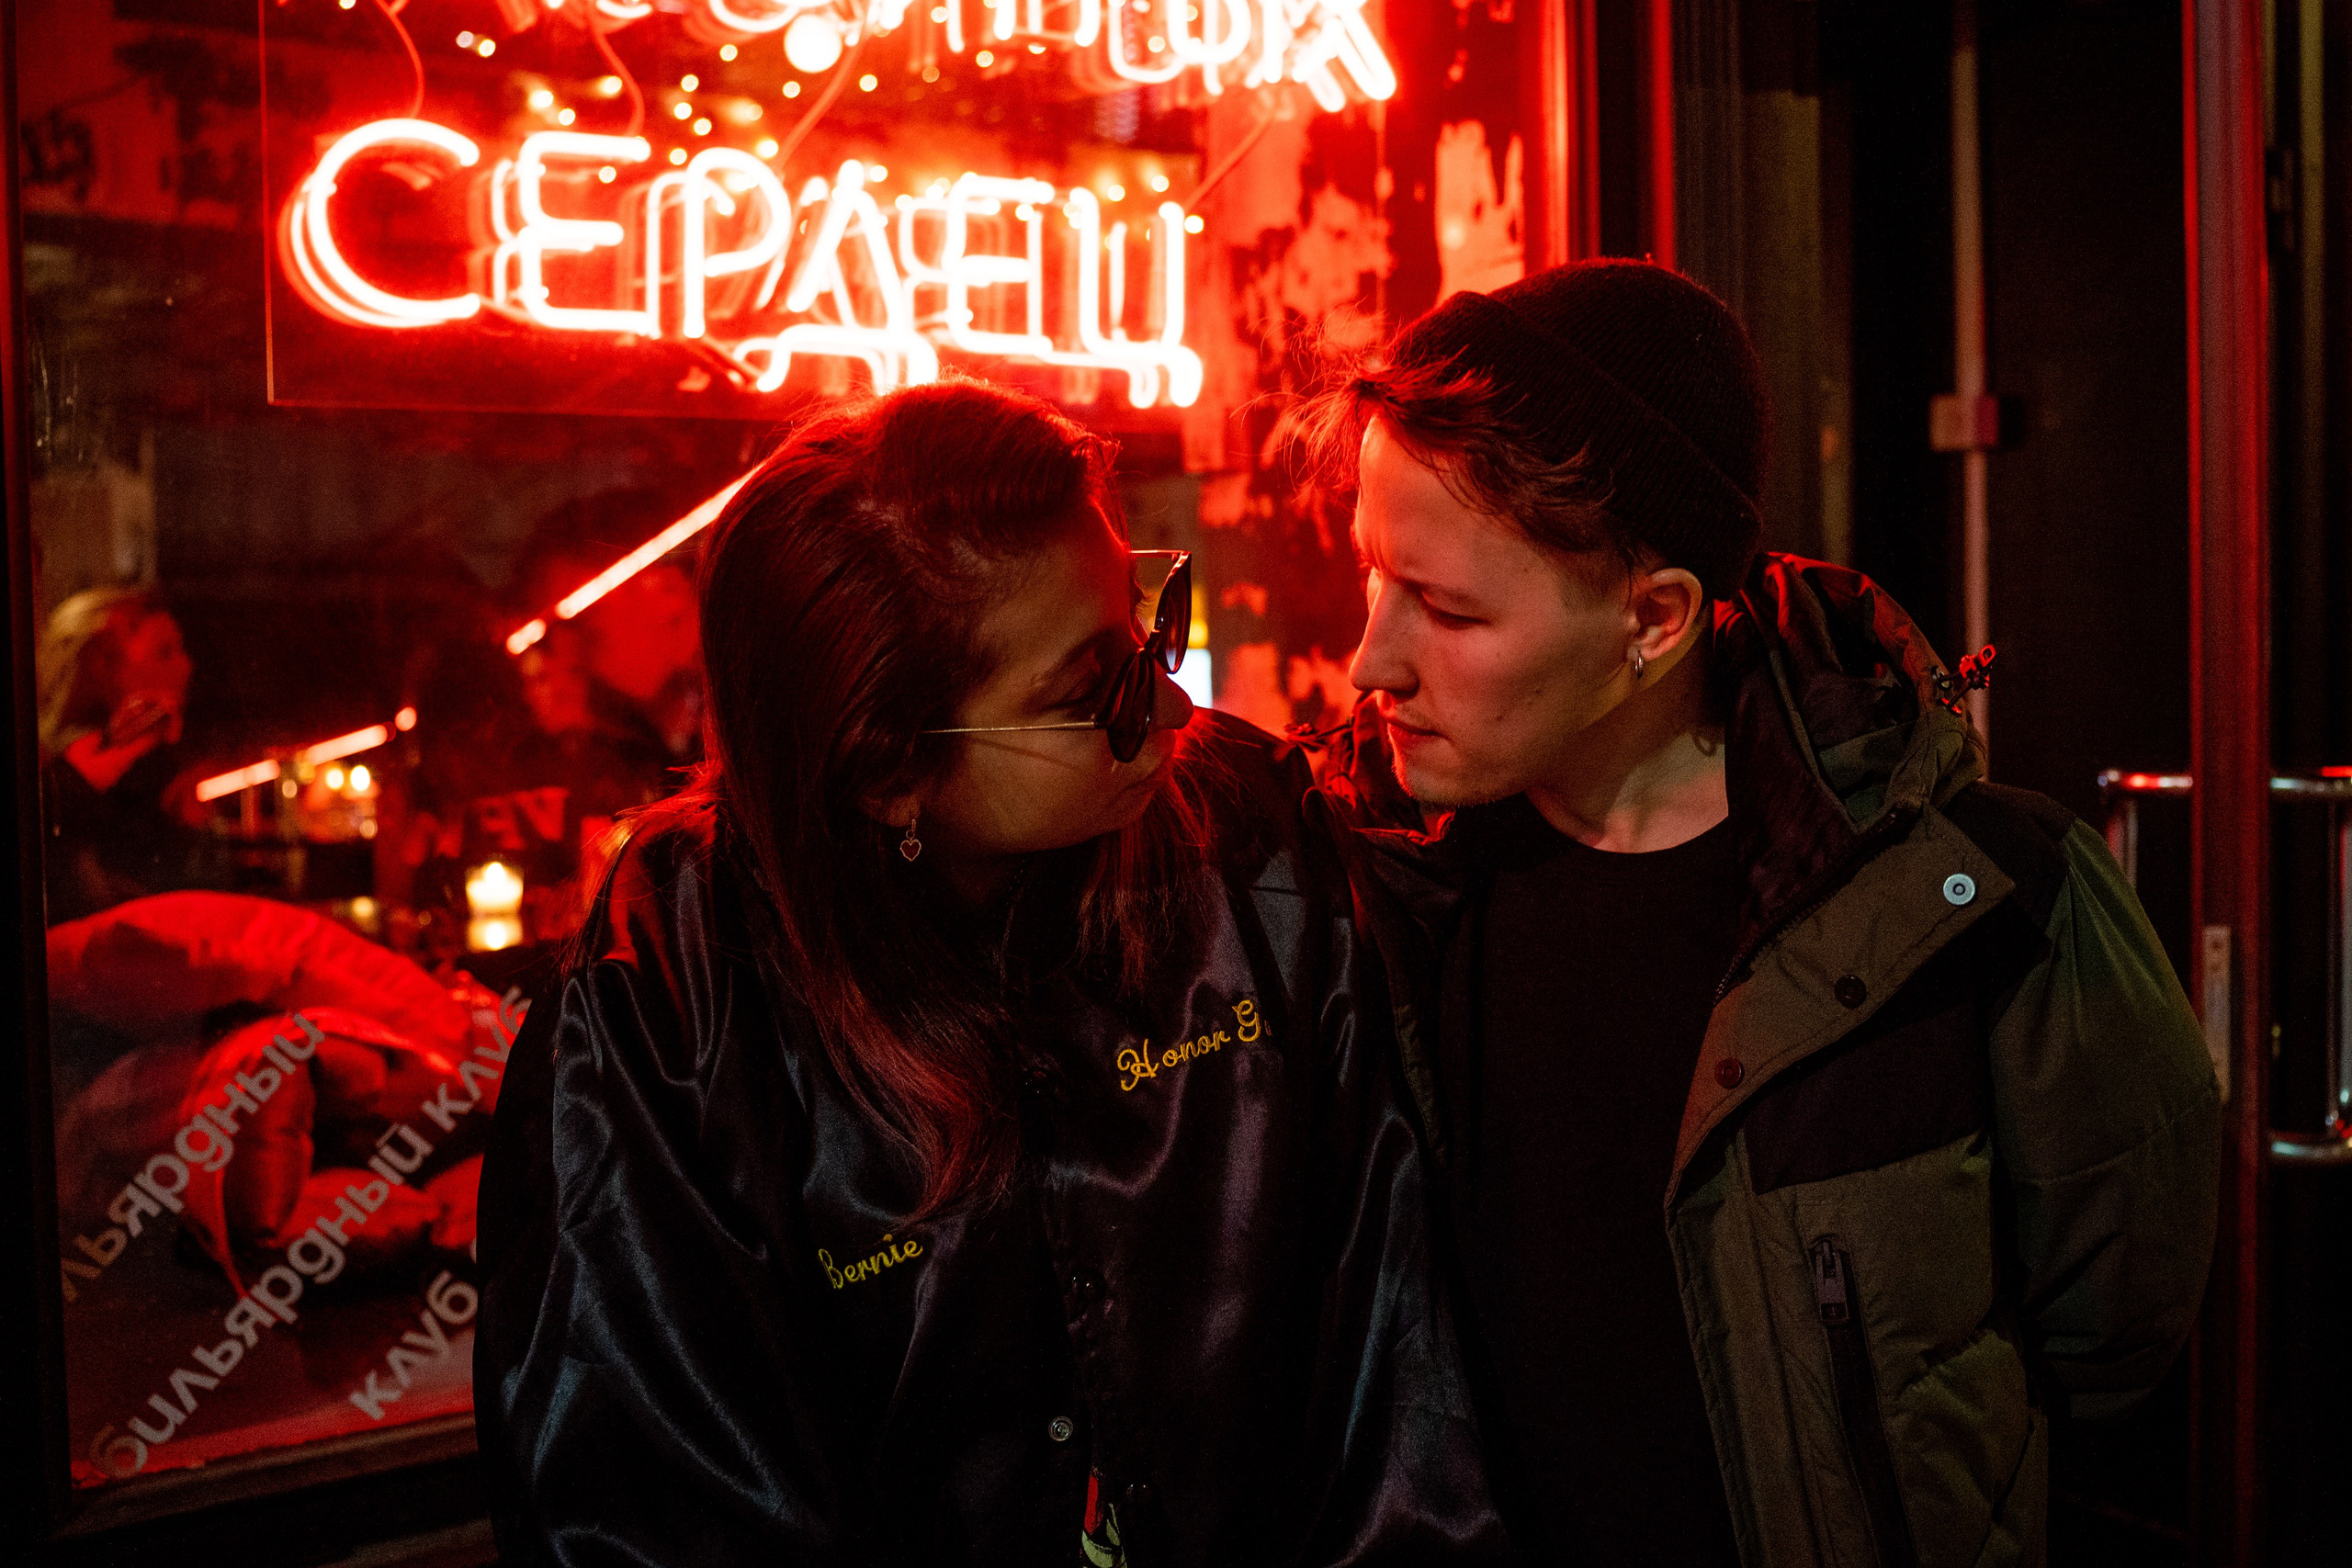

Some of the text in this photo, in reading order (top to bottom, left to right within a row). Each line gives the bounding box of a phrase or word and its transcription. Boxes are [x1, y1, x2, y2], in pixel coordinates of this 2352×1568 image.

[279, 116, 1204, 407] СЕРДЕЦ
[1117, 1038, 1231, 1091] Honor
[91, 1123, 434, 1478] бильярдный
[817, 1233, 923, 1290] Bernie
[348, 1269, 479, 1421] клуб
